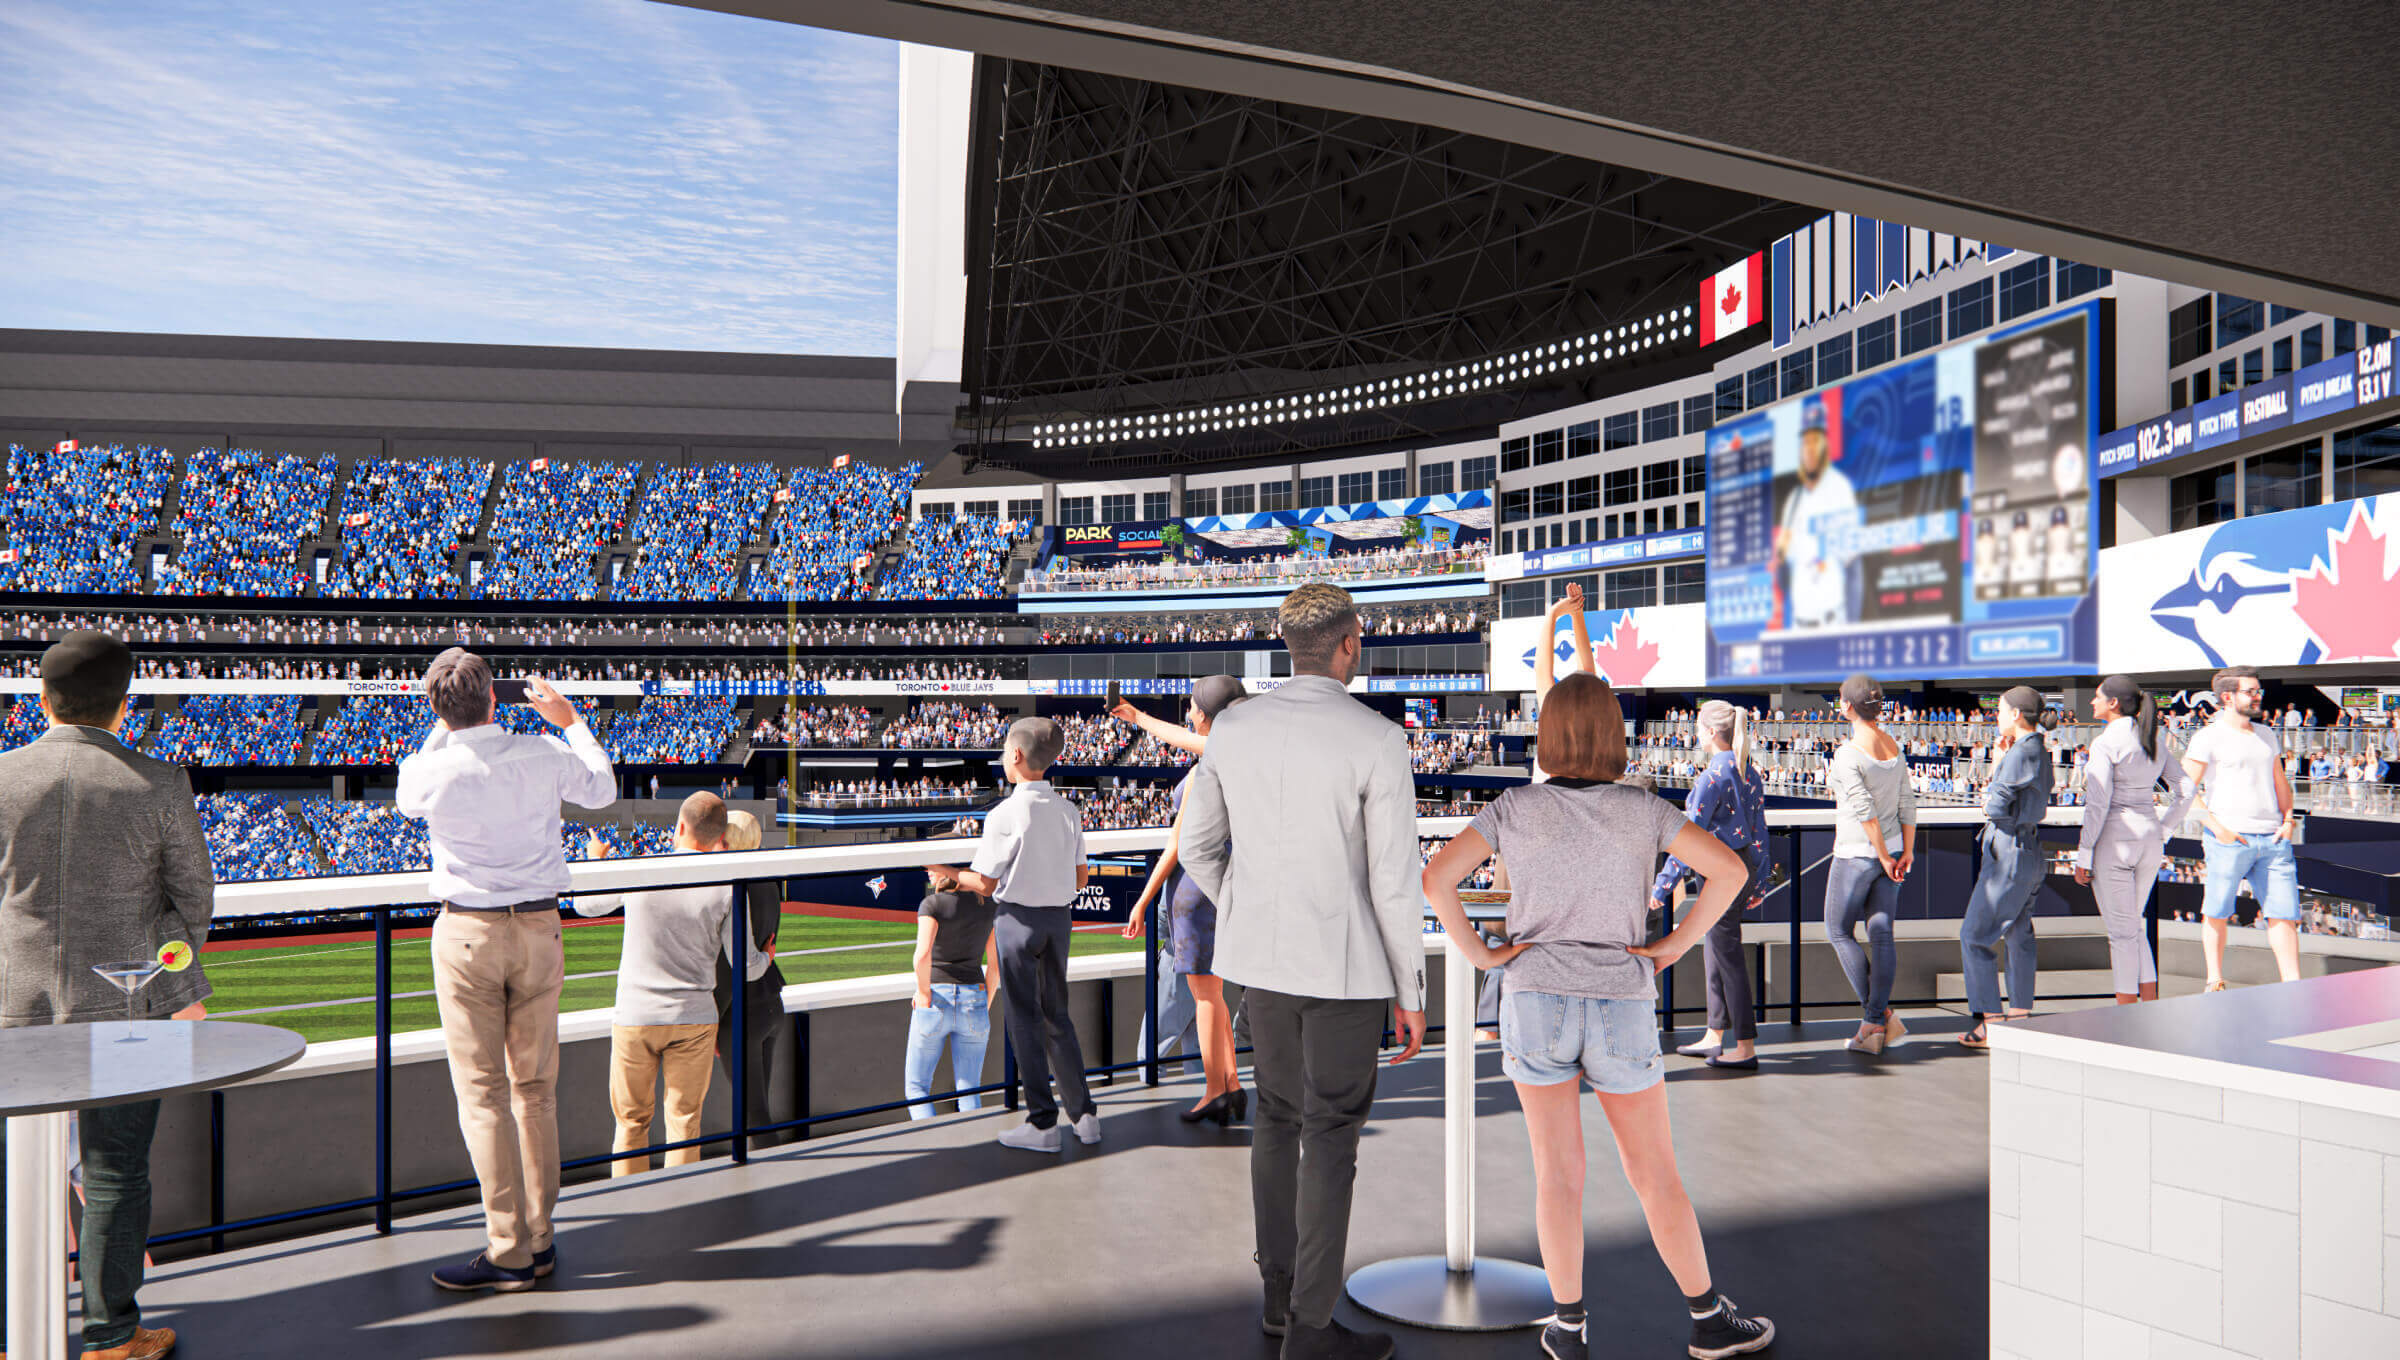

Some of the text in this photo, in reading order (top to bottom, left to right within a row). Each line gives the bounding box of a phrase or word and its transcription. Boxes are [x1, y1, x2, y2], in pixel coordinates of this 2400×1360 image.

[2300, 373, 2353, 407] PITCH BREAK
[2358, 370, 2392, 405] 13.1 V
[2243, 390, 2288, 425] FASTBALL
[2198, 408, 2239, 438] PITCH TYPE
[2137, 420, 2192, 463] 102.3 MPH
[2099, 442, 2136, 466] PITCH SPEED
[1066, 526, 1162, 541] PARK SOCIAL
[347, 683, 398, 691] TORONTO
[896, 683, 994, 691] TORONTO BLUE JAYS
[1913, 763, 1951, 777] FLIGHT
[1076, 896, 1111, 911] JAYS
